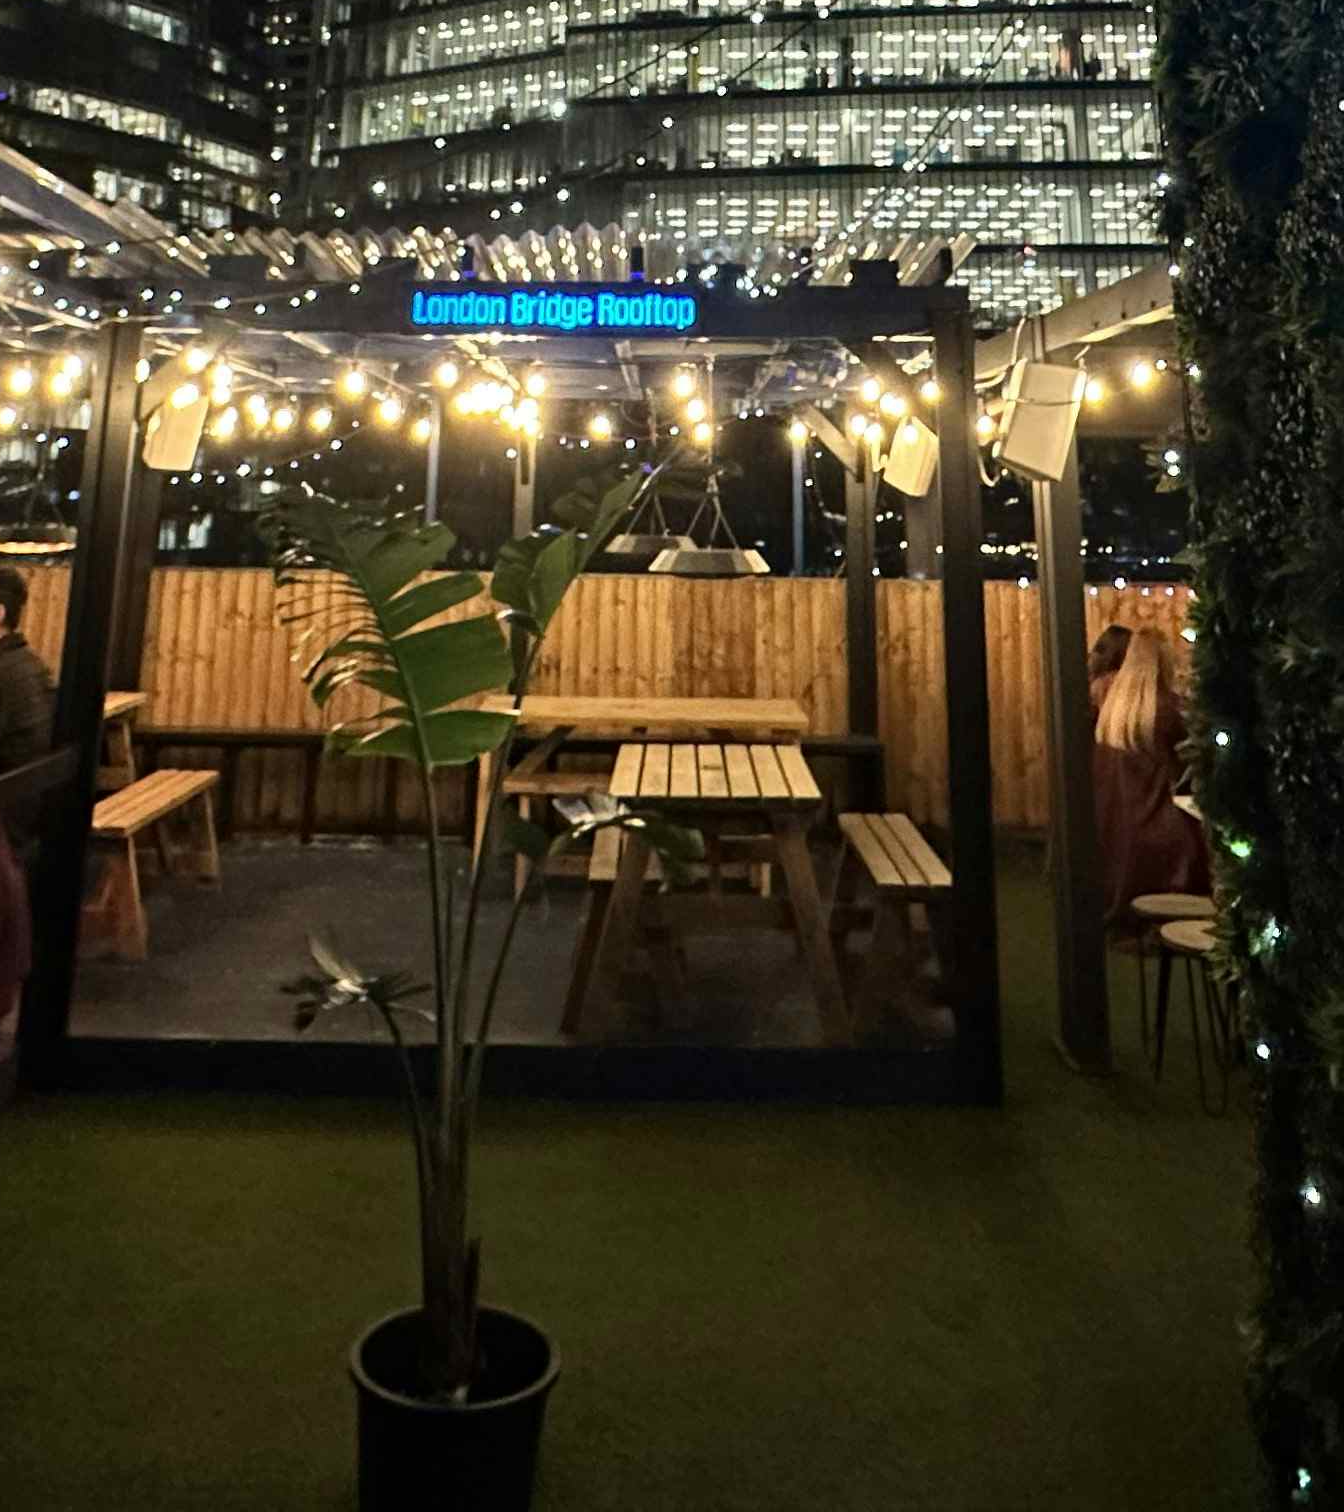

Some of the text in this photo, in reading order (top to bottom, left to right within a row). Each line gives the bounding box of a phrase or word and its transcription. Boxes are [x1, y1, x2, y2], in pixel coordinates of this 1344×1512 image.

[413, 290, 696, 329] London Bridge Rooftop
